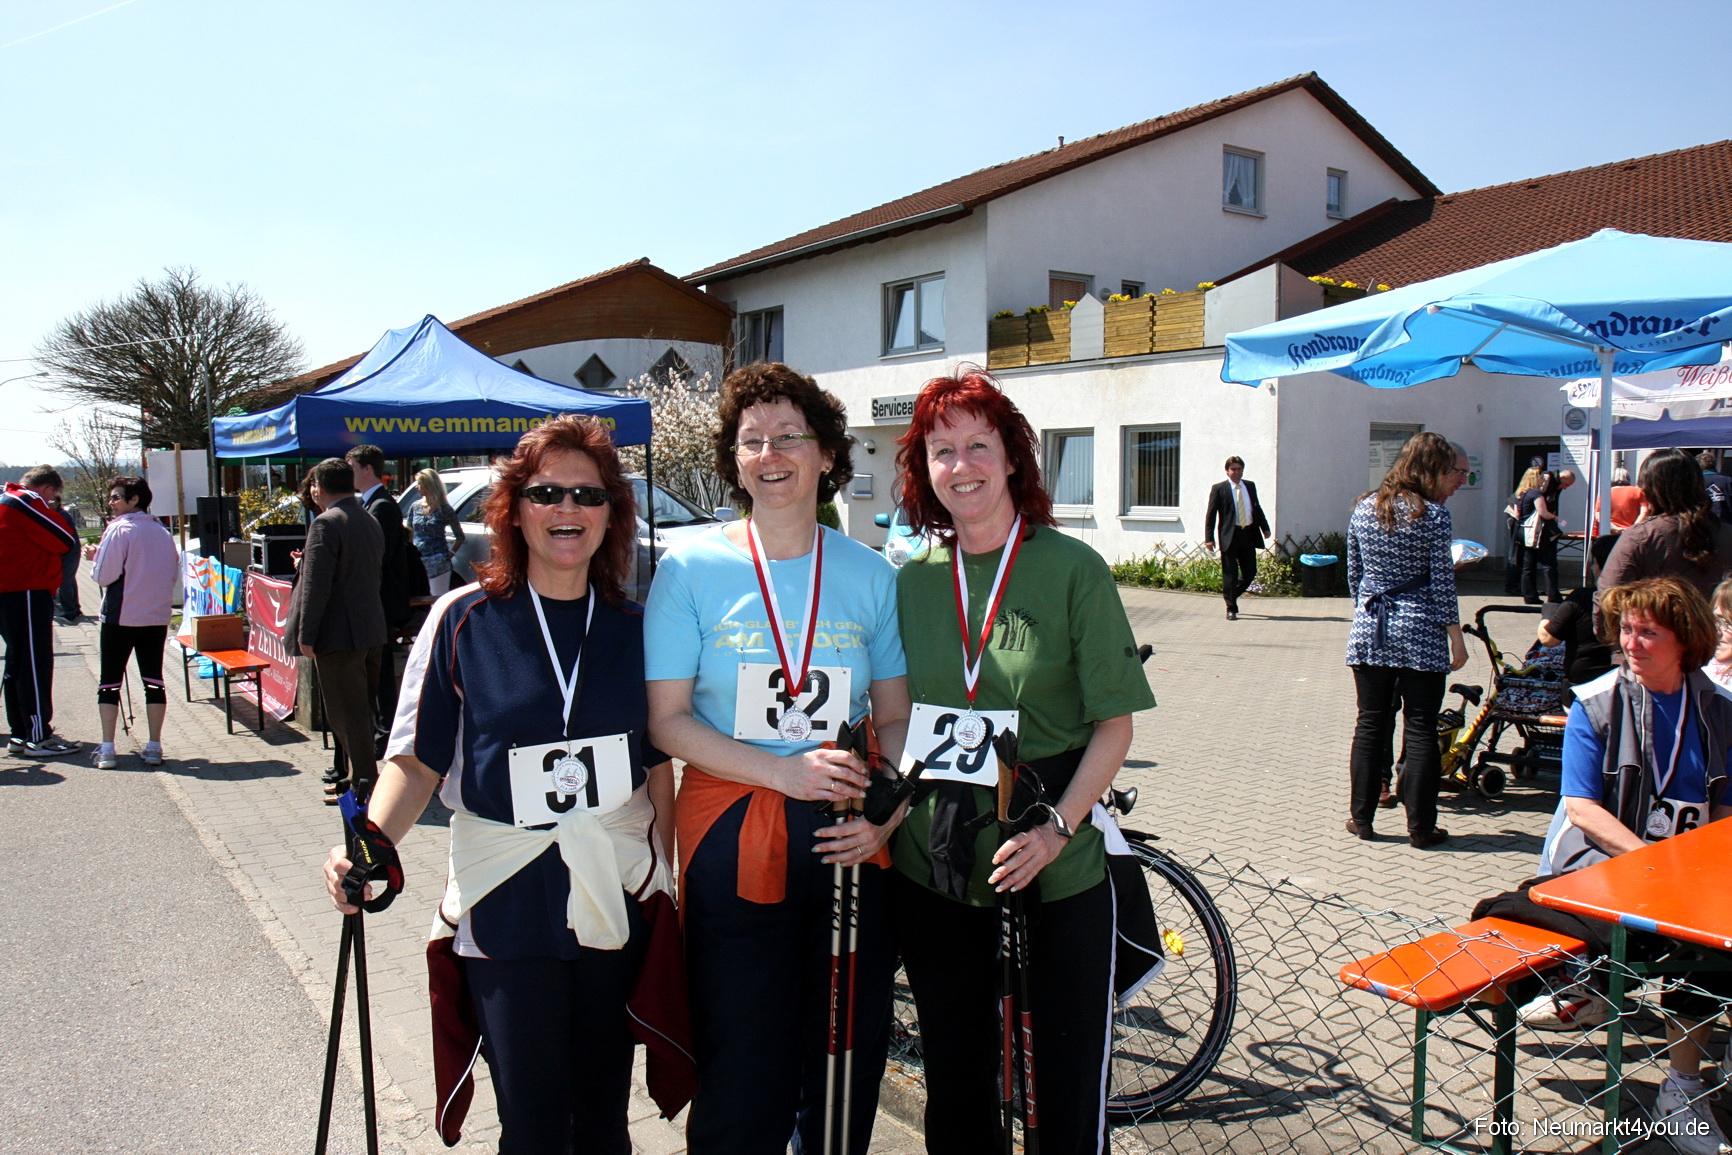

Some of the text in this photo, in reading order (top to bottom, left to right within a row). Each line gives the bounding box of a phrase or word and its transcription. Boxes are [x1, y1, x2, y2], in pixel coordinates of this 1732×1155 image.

[872, 397, 916, 418] Servicea
[715, 632, 764, 649] AM
[745, 620, 799, 629] GLAB'
[766, 669, 830, 730] 32
[924, 713, 995, 774] 29
[542, 745, 600, 813] 31
[1001, 906, 1011, 958] LEKI
[1022, 1026, 1036, 1115] Flash
